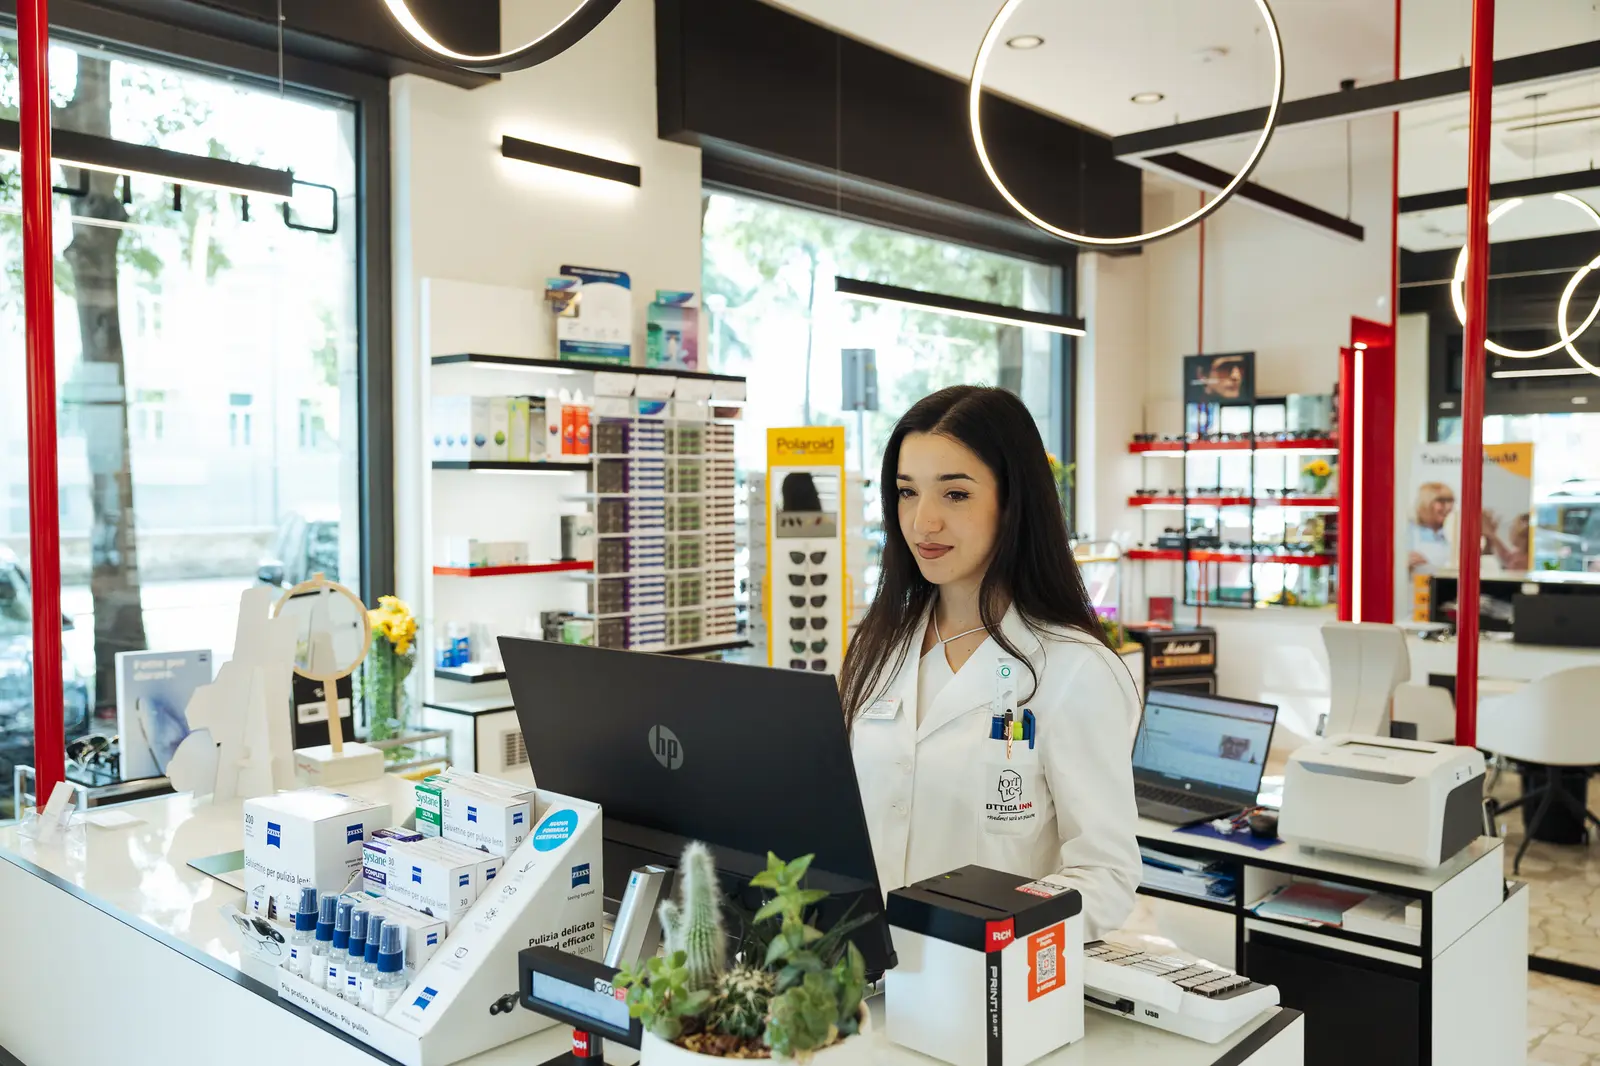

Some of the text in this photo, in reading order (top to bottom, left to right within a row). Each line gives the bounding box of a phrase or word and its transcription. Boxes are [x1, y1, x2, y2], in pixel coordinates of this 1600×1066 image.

[776, 437, 834, 450] Polaroid
[654, 725, 679, 770] hp
[416, 792, 438, 807] Systane
[444, 799, 449, 807] 30
[986, 802, 1032, 811] OTTICA INN
[245, 814, 254, 824] 200
[422, 811, 434, 819] ULTRA
[363, 849, 387, 866] Systane
[388, 857, 394, 866] 30
[267, 869, 276, 878] per
[277, 871, 296, 884] pulizia
[365, 868, 384, 880] COMPLETE
[567, 889, 595, 902] Seeing beyond
[529, 921, 595, 946] Pulizia delicata
[992, 929, 1011, 941] RCH
[562, 932, 595, 948] efficace
[1145, 1009, 1159, 1019] USB
